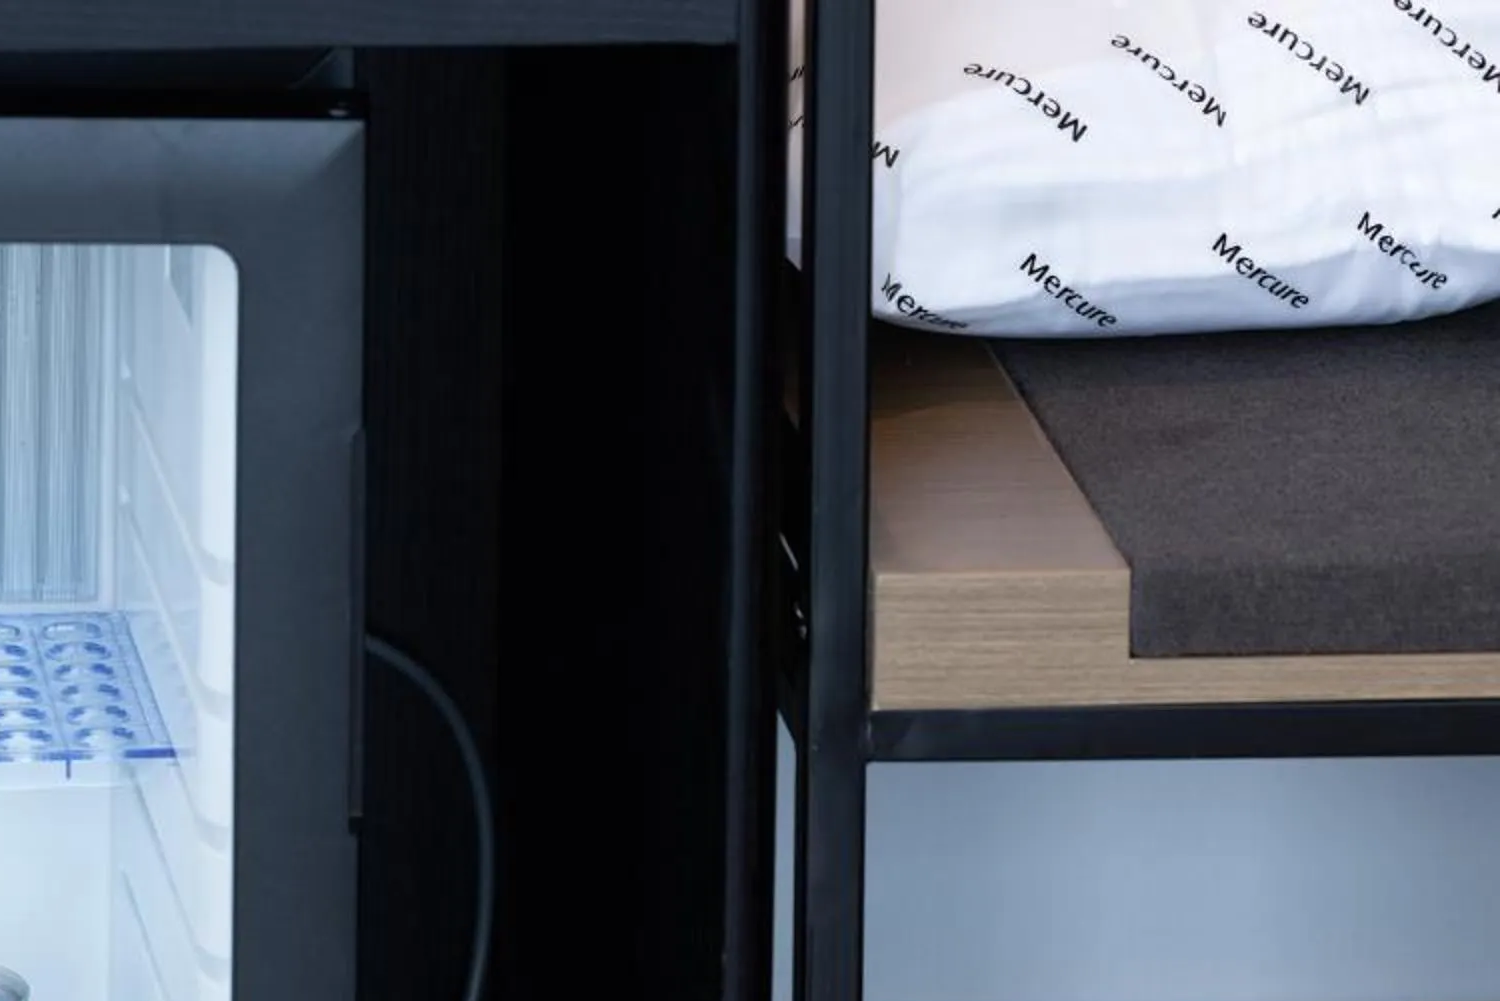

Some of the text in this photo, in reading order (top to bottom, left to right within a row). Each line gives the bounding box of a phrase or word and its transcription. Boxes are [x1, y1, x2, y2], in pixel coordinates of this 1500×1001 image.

[1110, 33, 1227, 128] Mercure
[1248, 11, 1370, 106] Mercure
[963, 62, 1088, 143] Mercure
[1019, 252, 1118, 328] Mercure
[1211, 232, 1310, 309] Mercure
